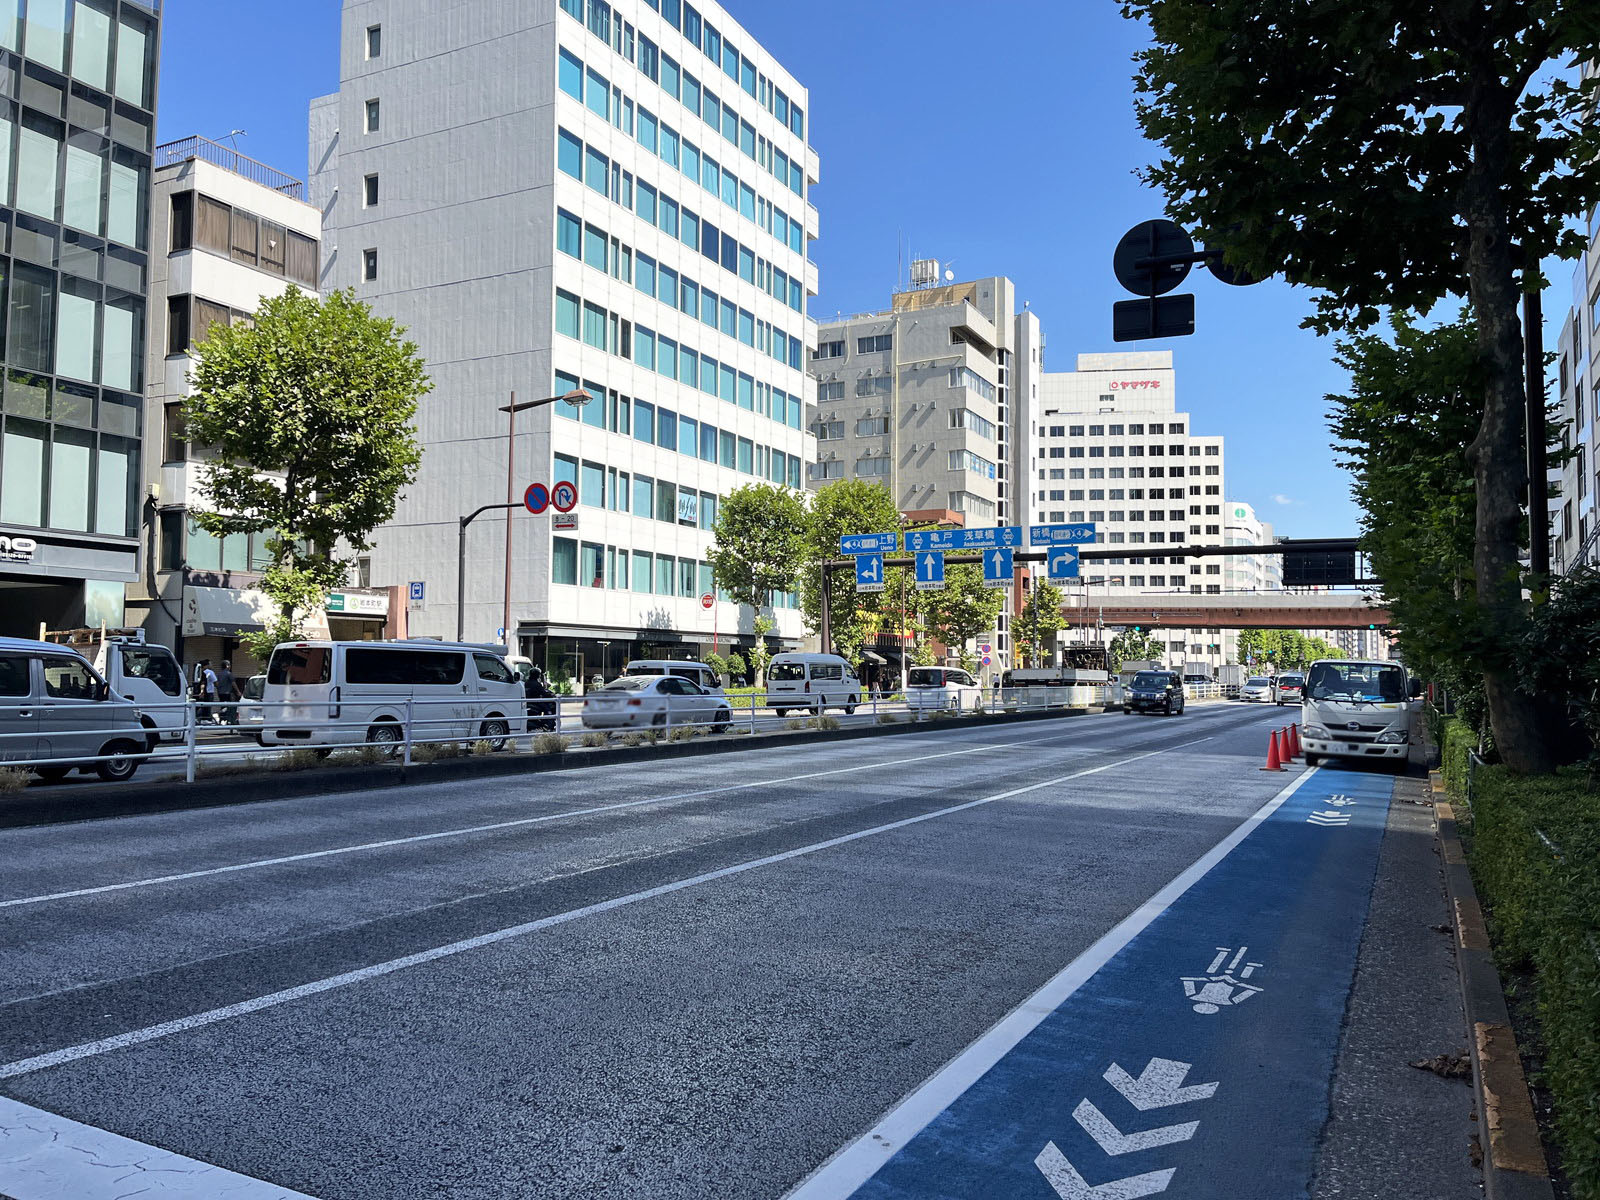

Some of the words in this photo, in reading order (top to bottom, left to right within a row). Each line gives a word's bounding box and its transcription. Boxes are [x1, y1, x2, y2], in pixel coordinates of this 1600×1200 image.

[1120, 380, 1160, 389] ヤマザキ
[930, 532, 953, 542] 亀戸
[964, 530, 995, 540] 浅草橋
[1032, 528, 1050, 538] 新橋
[879, 534, 894, 544] 上野
